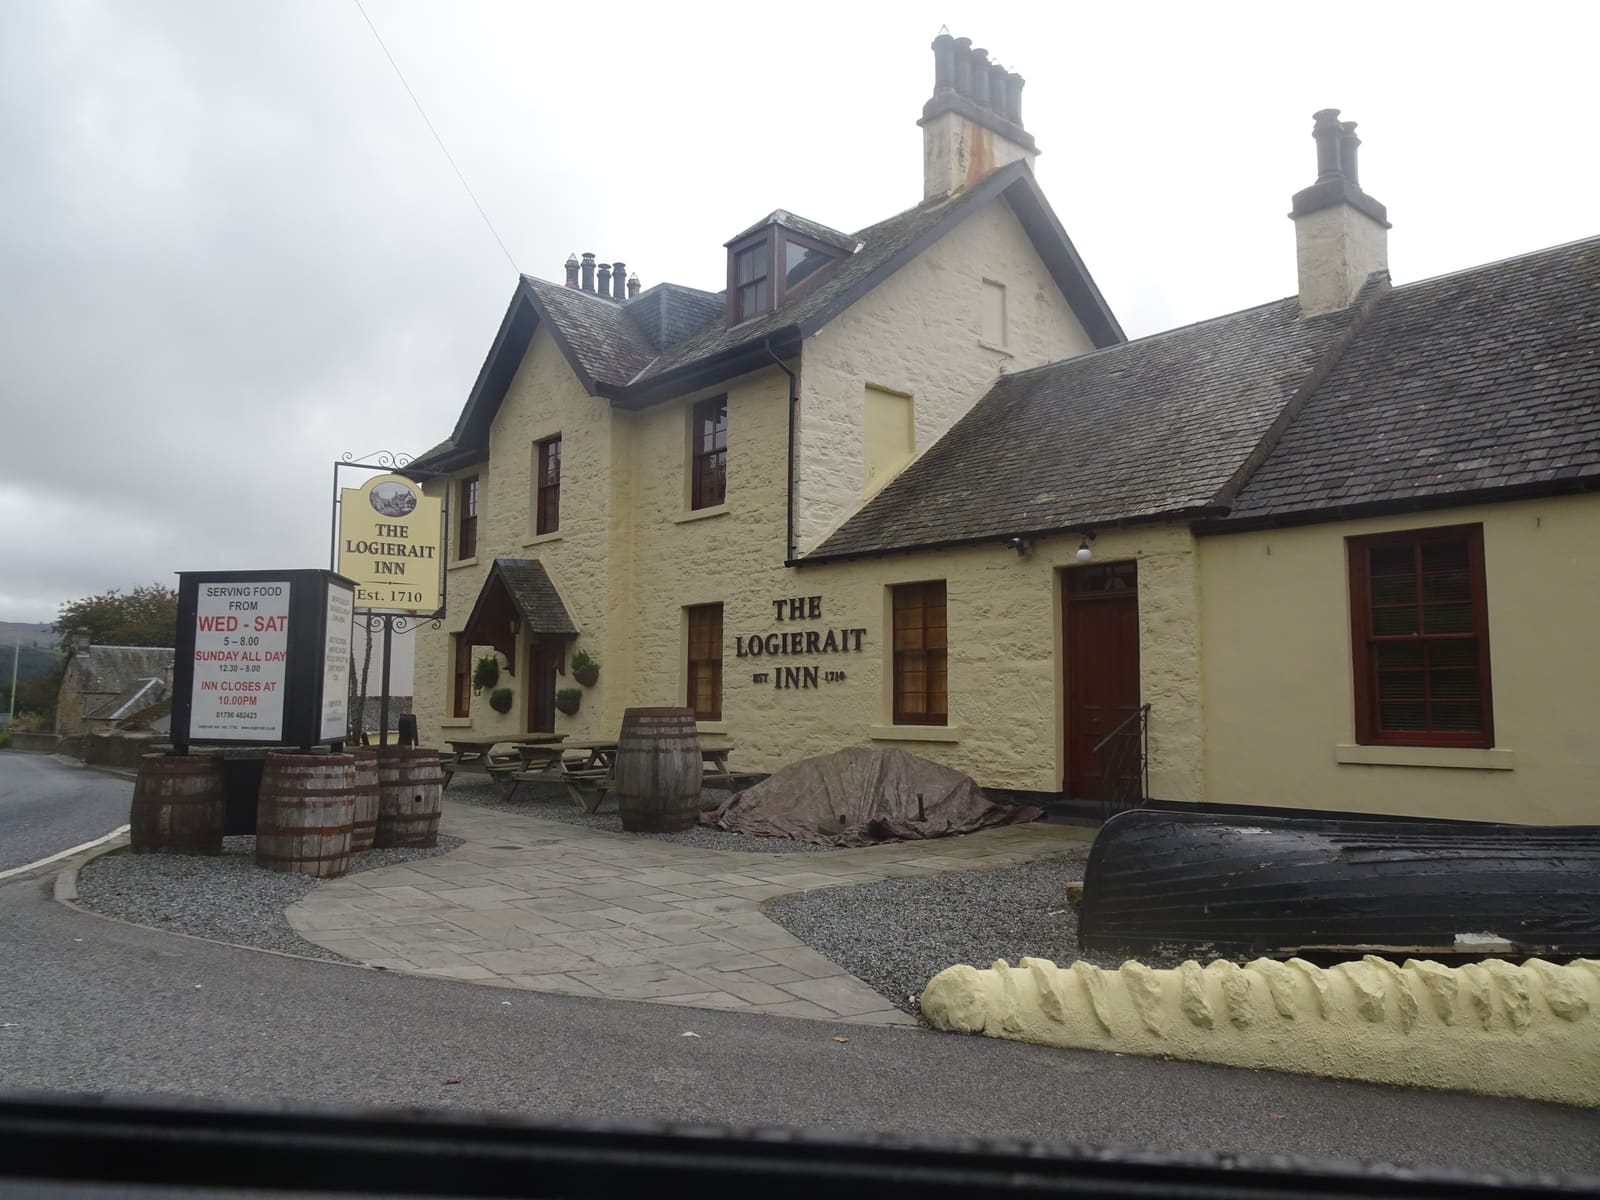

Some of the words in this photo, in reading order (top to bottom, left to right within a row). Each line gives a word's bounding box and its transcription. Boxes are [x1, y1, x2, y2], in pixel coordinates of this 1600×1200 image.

[376, 524, 408, 538] THE
[346, 540, 435, 558] LOGIERAIT
[374, 561, 405, 575] INN
[207, 587, 250, 596] SERVING
[254, 587, 282, 596] FOOD
[357, 589, 384, 600] Est.
[391, 591, 422, 602] 1710
[229, 601, 258, 610] FROM
[772, 596, 822, 620] THE
[199, 616, 238, 632] WED
[254, 616, 287, 632] SAT
[224, 636, 230, 646] 5
[240, 636, 258, 646] 8.00
[736, 628, 866, 657] LOGIERAIT
[196, 651, 239, 661] SUNDAY
[241, 651, 262, 662] ALL
[265, 651, 286, 662] DAY
[752, 673, 769, 683] EST
[775, 666, 819, 689] INN
[825, 671, 846, 682] 1710
[201, 682, 218, 690] INN
[221, 682, 260, 691] CLOSES
[264, 682, 277, 691] AT
[219, 696, 257, 705] 10.00PM
